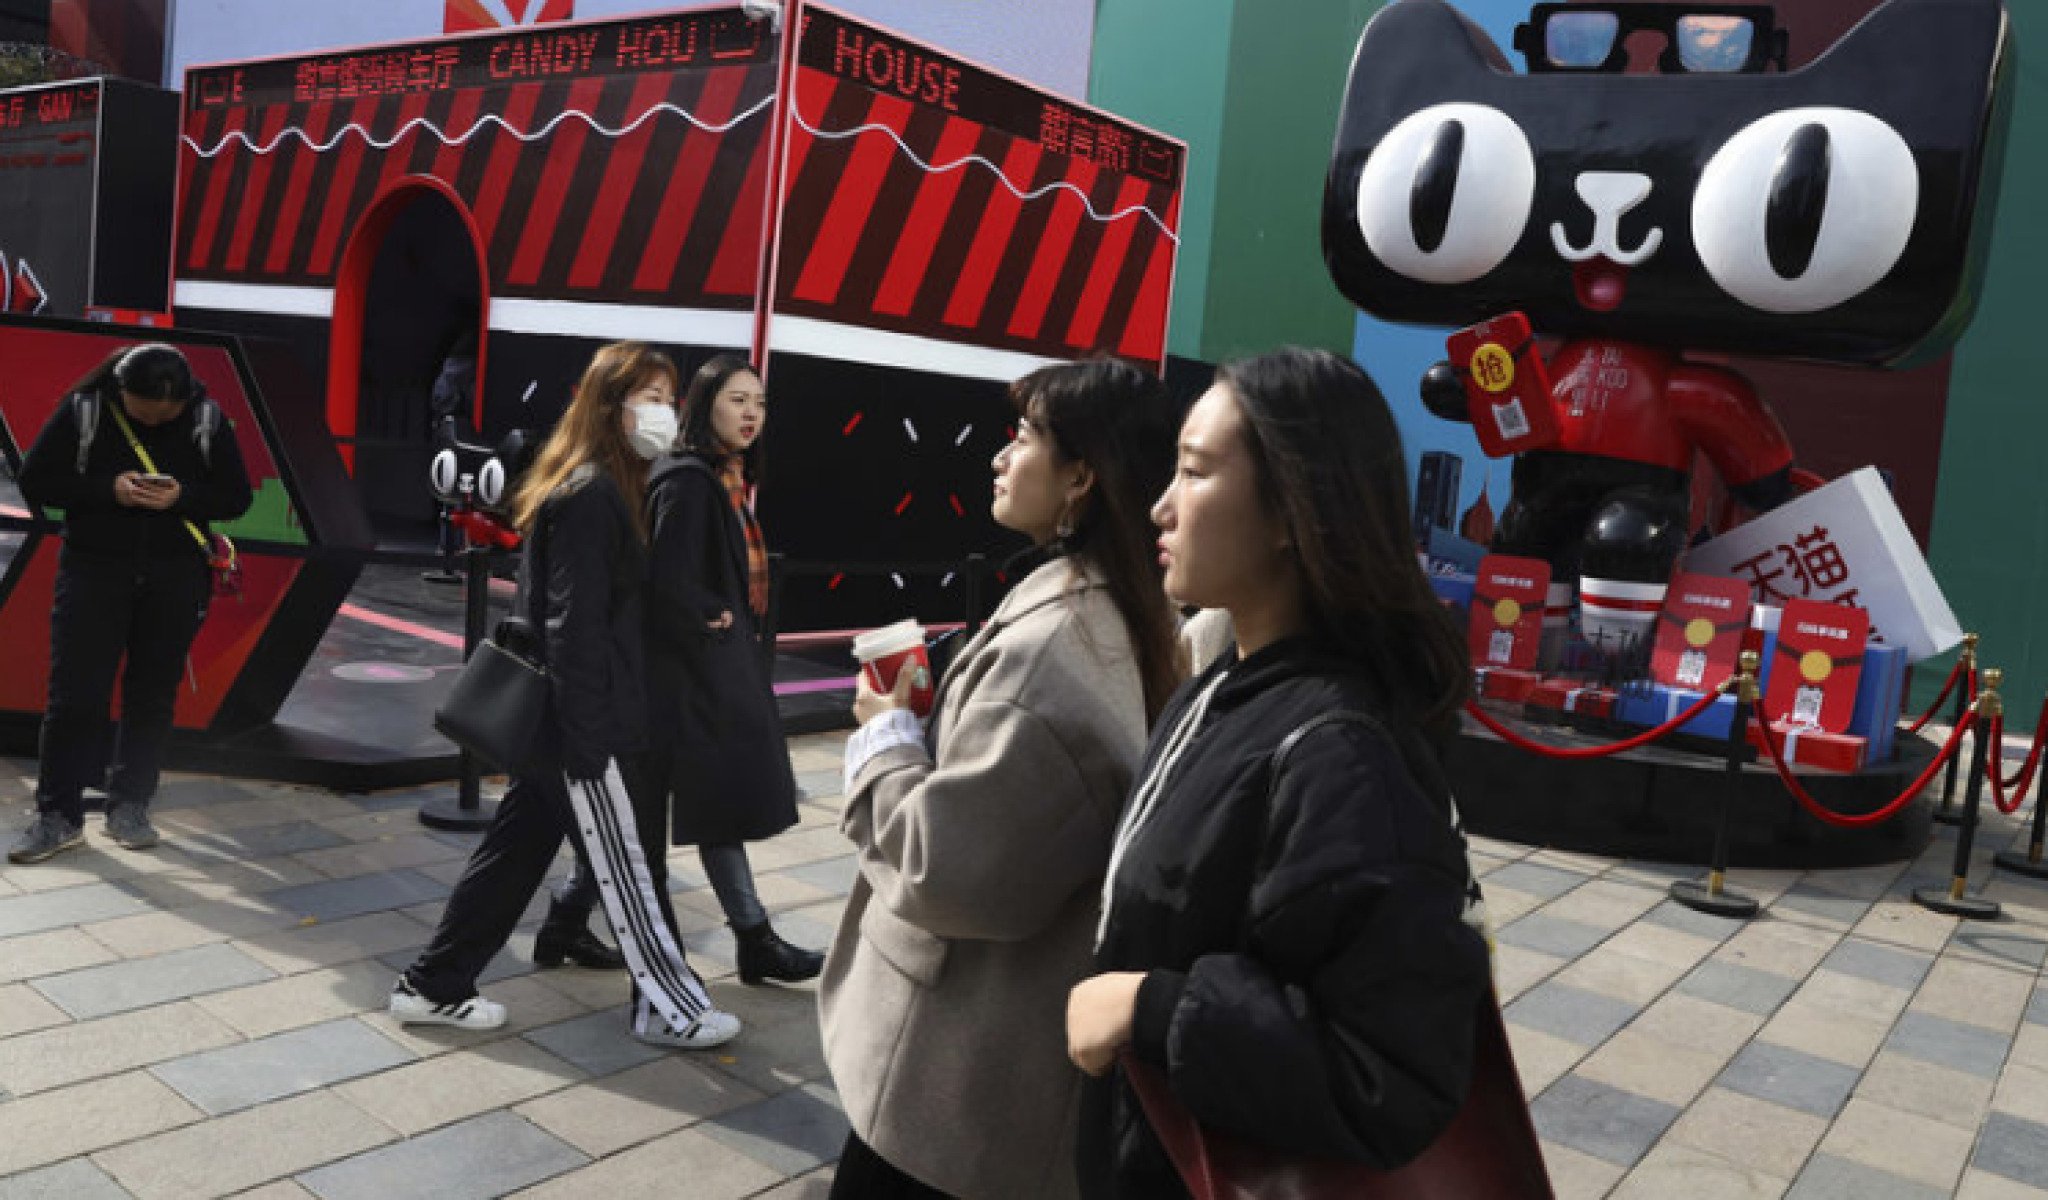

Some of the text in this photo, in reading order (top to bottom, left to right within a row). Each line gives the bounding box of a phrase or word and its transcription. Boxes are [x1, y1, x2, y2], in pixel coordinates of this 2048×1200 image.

[489, 31, 599, 79] CANDY
[834, 26, 961, 111] HOUSE
[1731, 523, 1848, 604] 天猫
